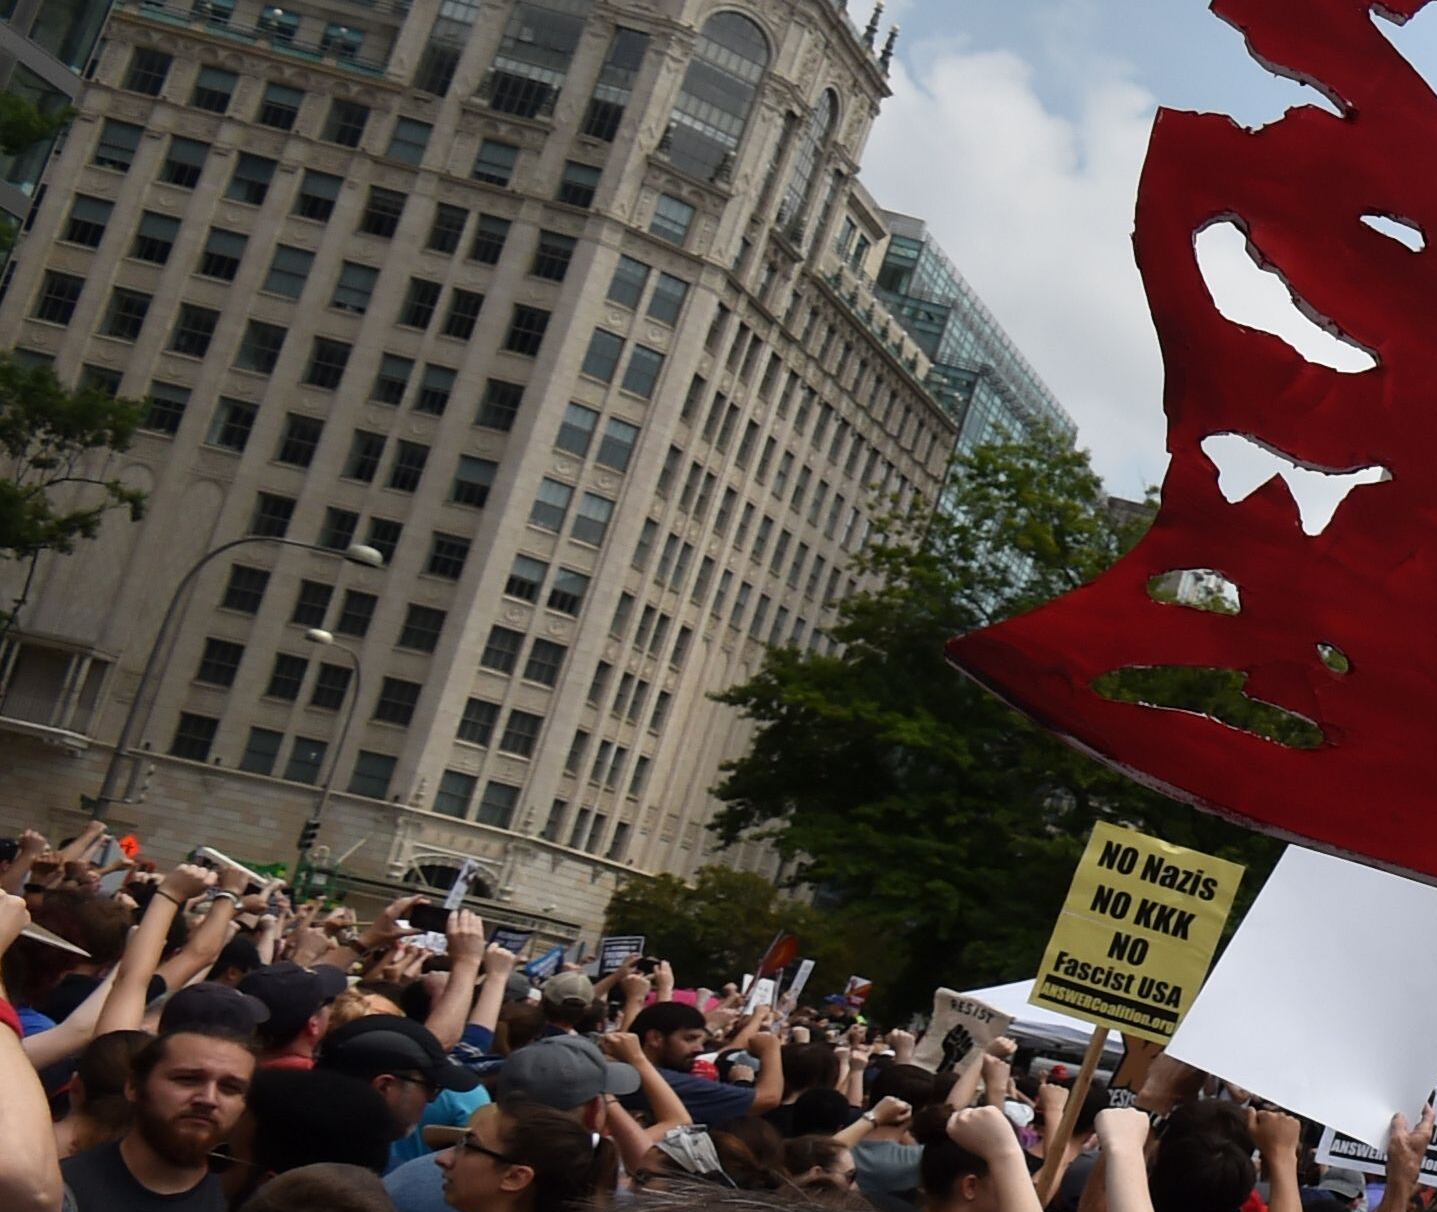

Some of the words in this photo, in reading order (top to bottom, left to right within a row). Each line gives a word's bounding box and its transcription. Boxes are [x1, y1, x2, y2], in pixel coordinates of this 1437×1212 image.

[1098, 840, 1139, 875] NO
[1140, 854, 1218, 901] Nazis
[1090, 884, 1132, 920] NO
[1133, 899, 1198, 941] KKK
[1107, 931, 1149, 966] NO
[1053, 950, 1135, 995] Fascist
[1137, 976, 1183, 1009] USA
[950, 998, 994, 1024] RESIST
[1041, 982, 1177, 1035] ANSWERCoalition.org
